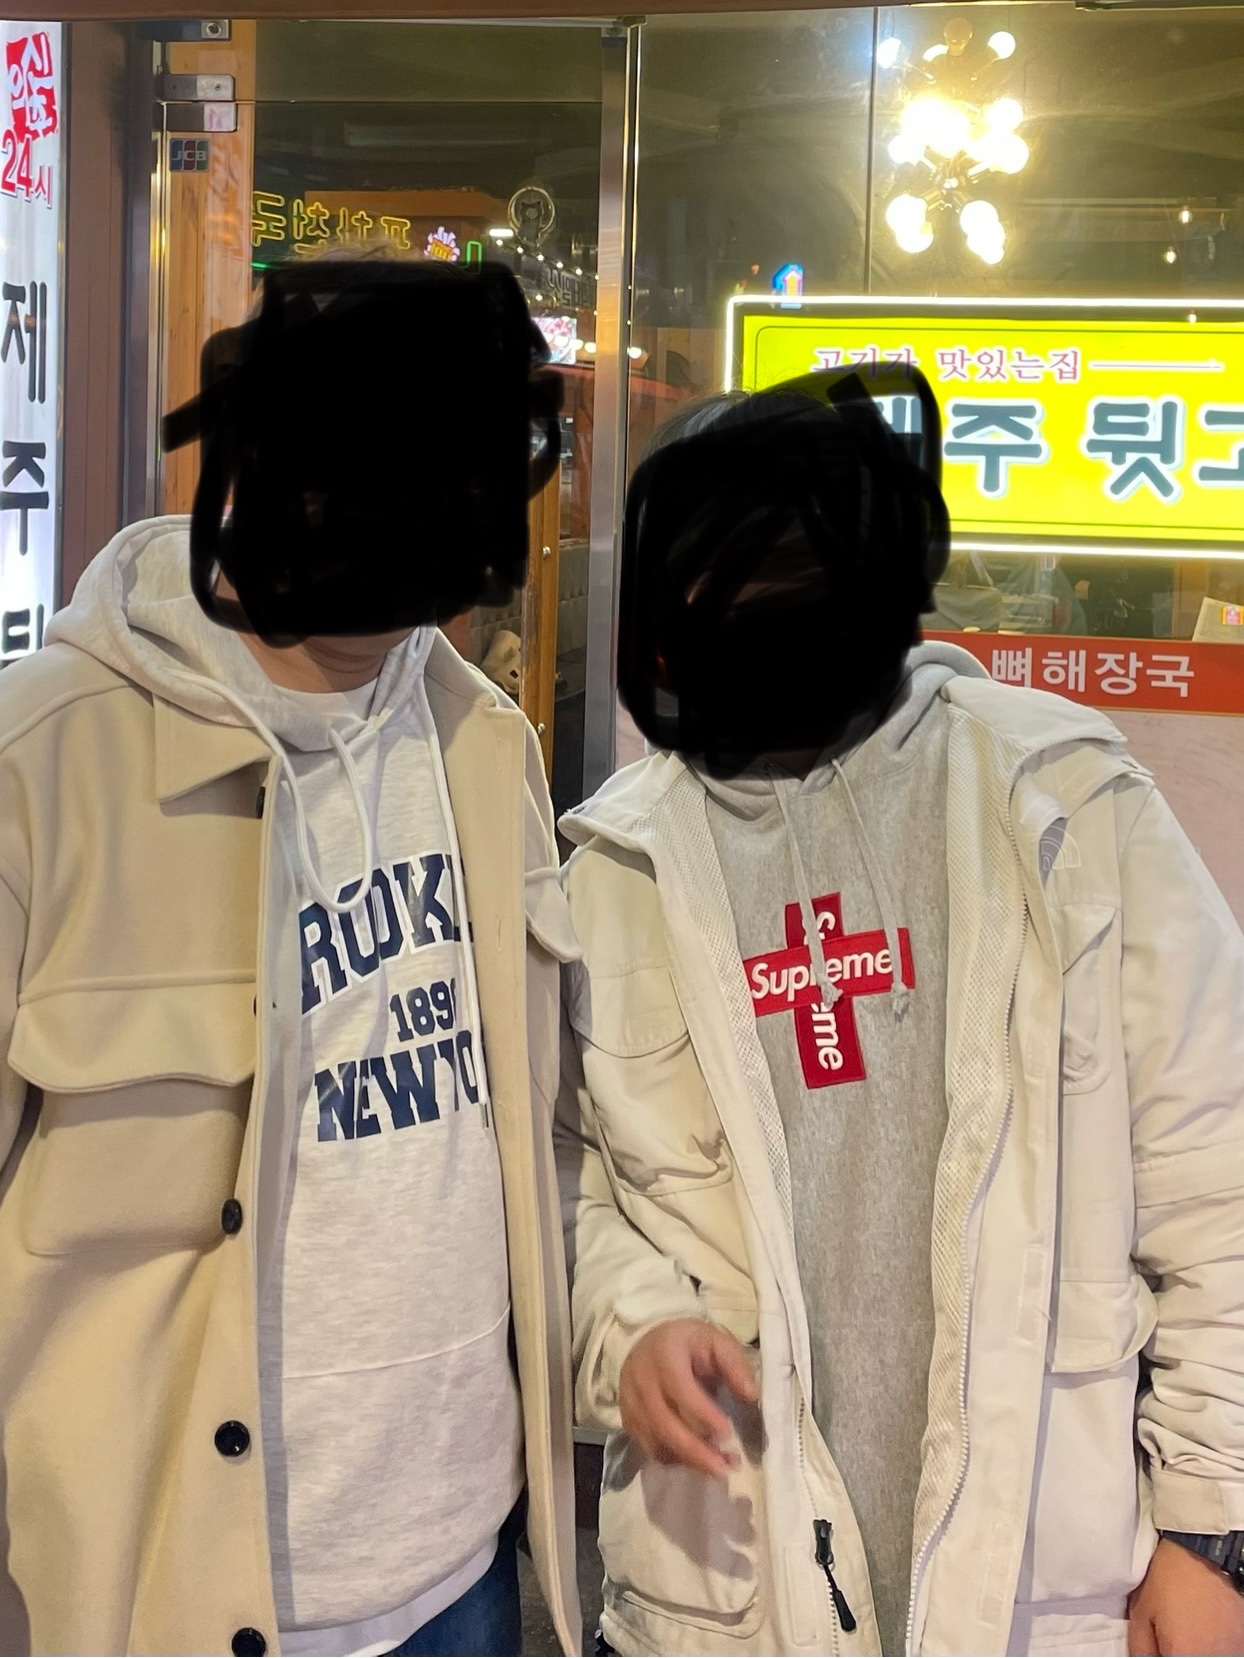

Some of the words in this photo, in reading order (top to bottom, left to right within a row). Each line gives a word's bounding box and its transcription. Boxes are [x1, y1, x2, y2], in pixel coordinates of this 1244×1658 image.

[1, 129, 52, 208] 24시
[171, 150, 207, 161] JCB
[812, 347, 918, 377] 고기가
[938, 347, 1080, 380] 맛있는집
[874, 396, 1043, 494] 주
[992, 647, 1195, 698] 뼈해장국
